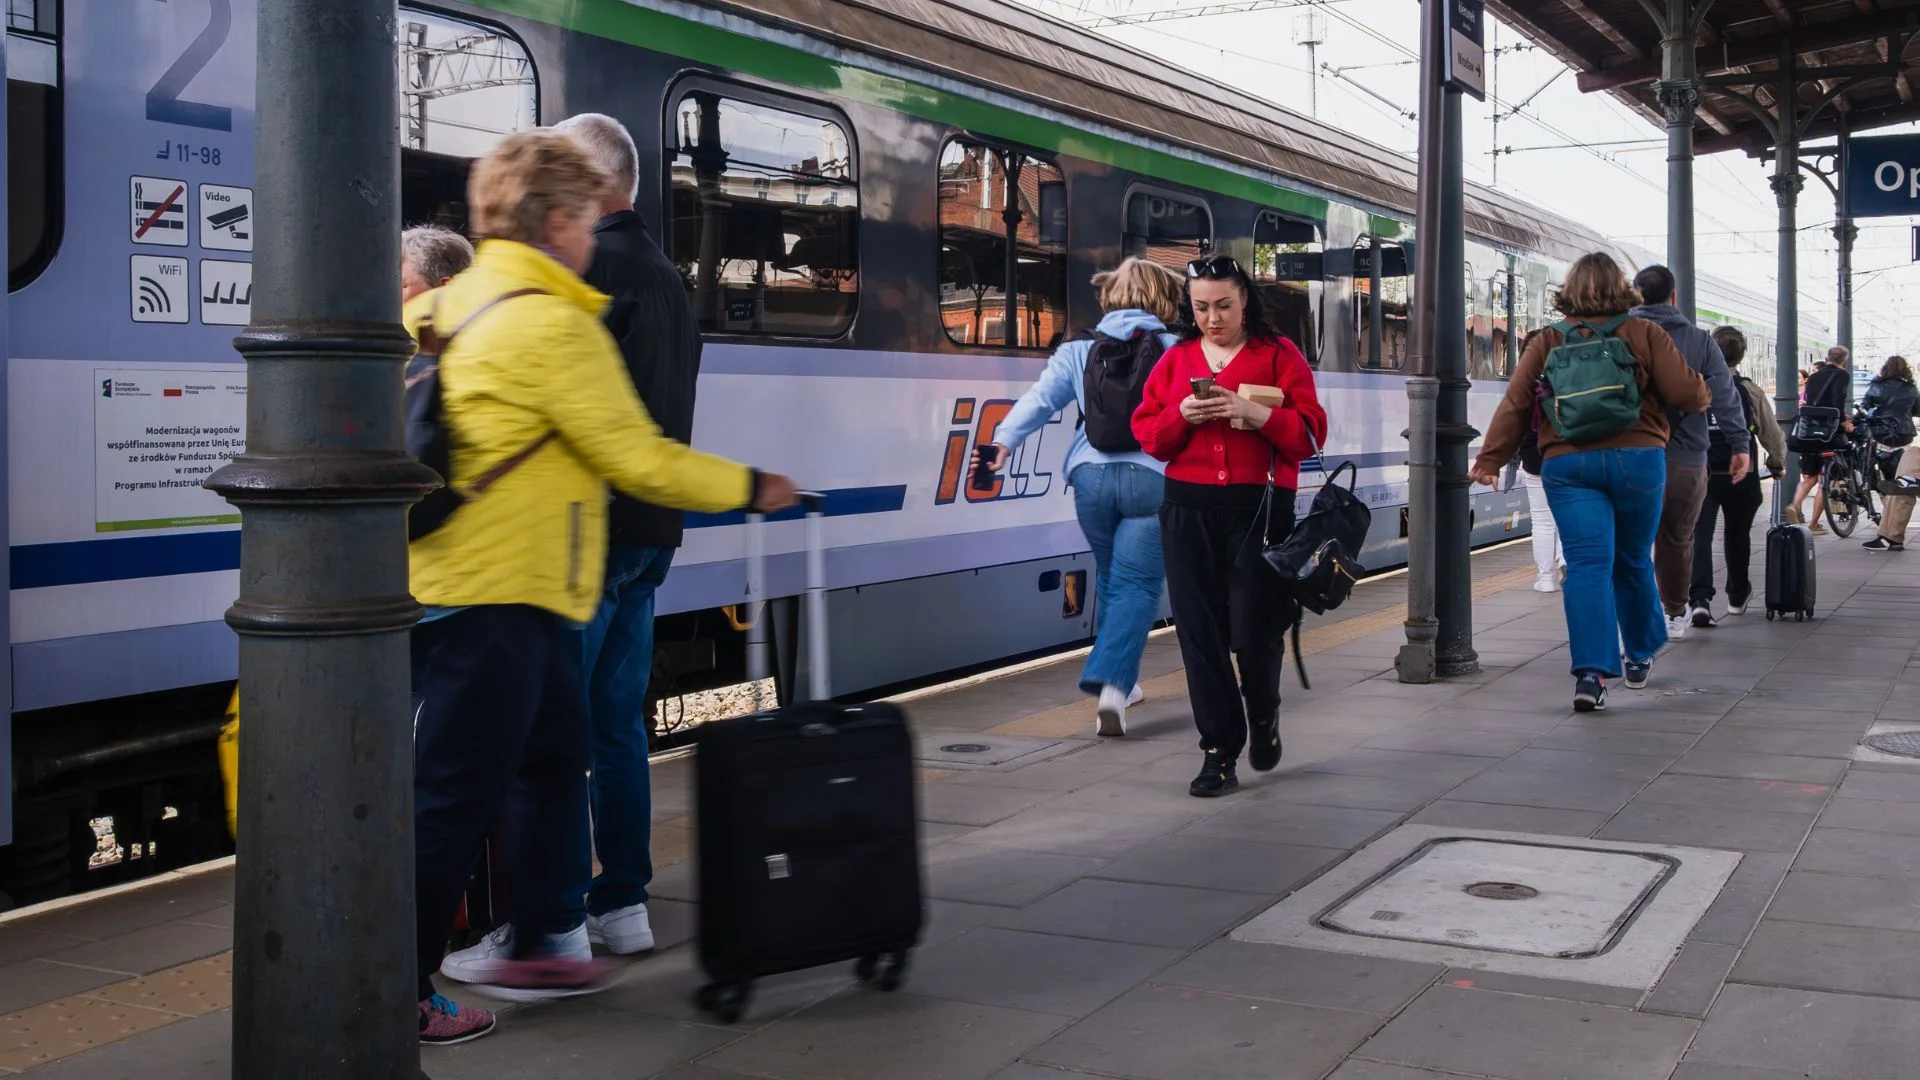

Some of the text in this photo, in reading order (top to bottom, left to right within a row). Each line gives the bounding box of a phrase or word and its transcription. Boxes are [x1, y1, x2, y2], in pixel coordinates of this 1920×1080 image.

[146, 0, 232, 132] 2
[176, 143, 222, 167] 11-98
[204, 191, 231, 203] Video
[158, 264, 182, 277] WiFi
[146, 425, 240, 436] Modernizacja wagonów
[107, 440, 186, 451] współfinansowana
[187, 440, 210, 449] przez
[212, 439, 230, 448] Unię
[140, 453, 177, 462] środków
[178, 452, 217, 461] Funduszu
[183, 464, 213, 474] ramach
[114, 481, 157, 491] Programu
